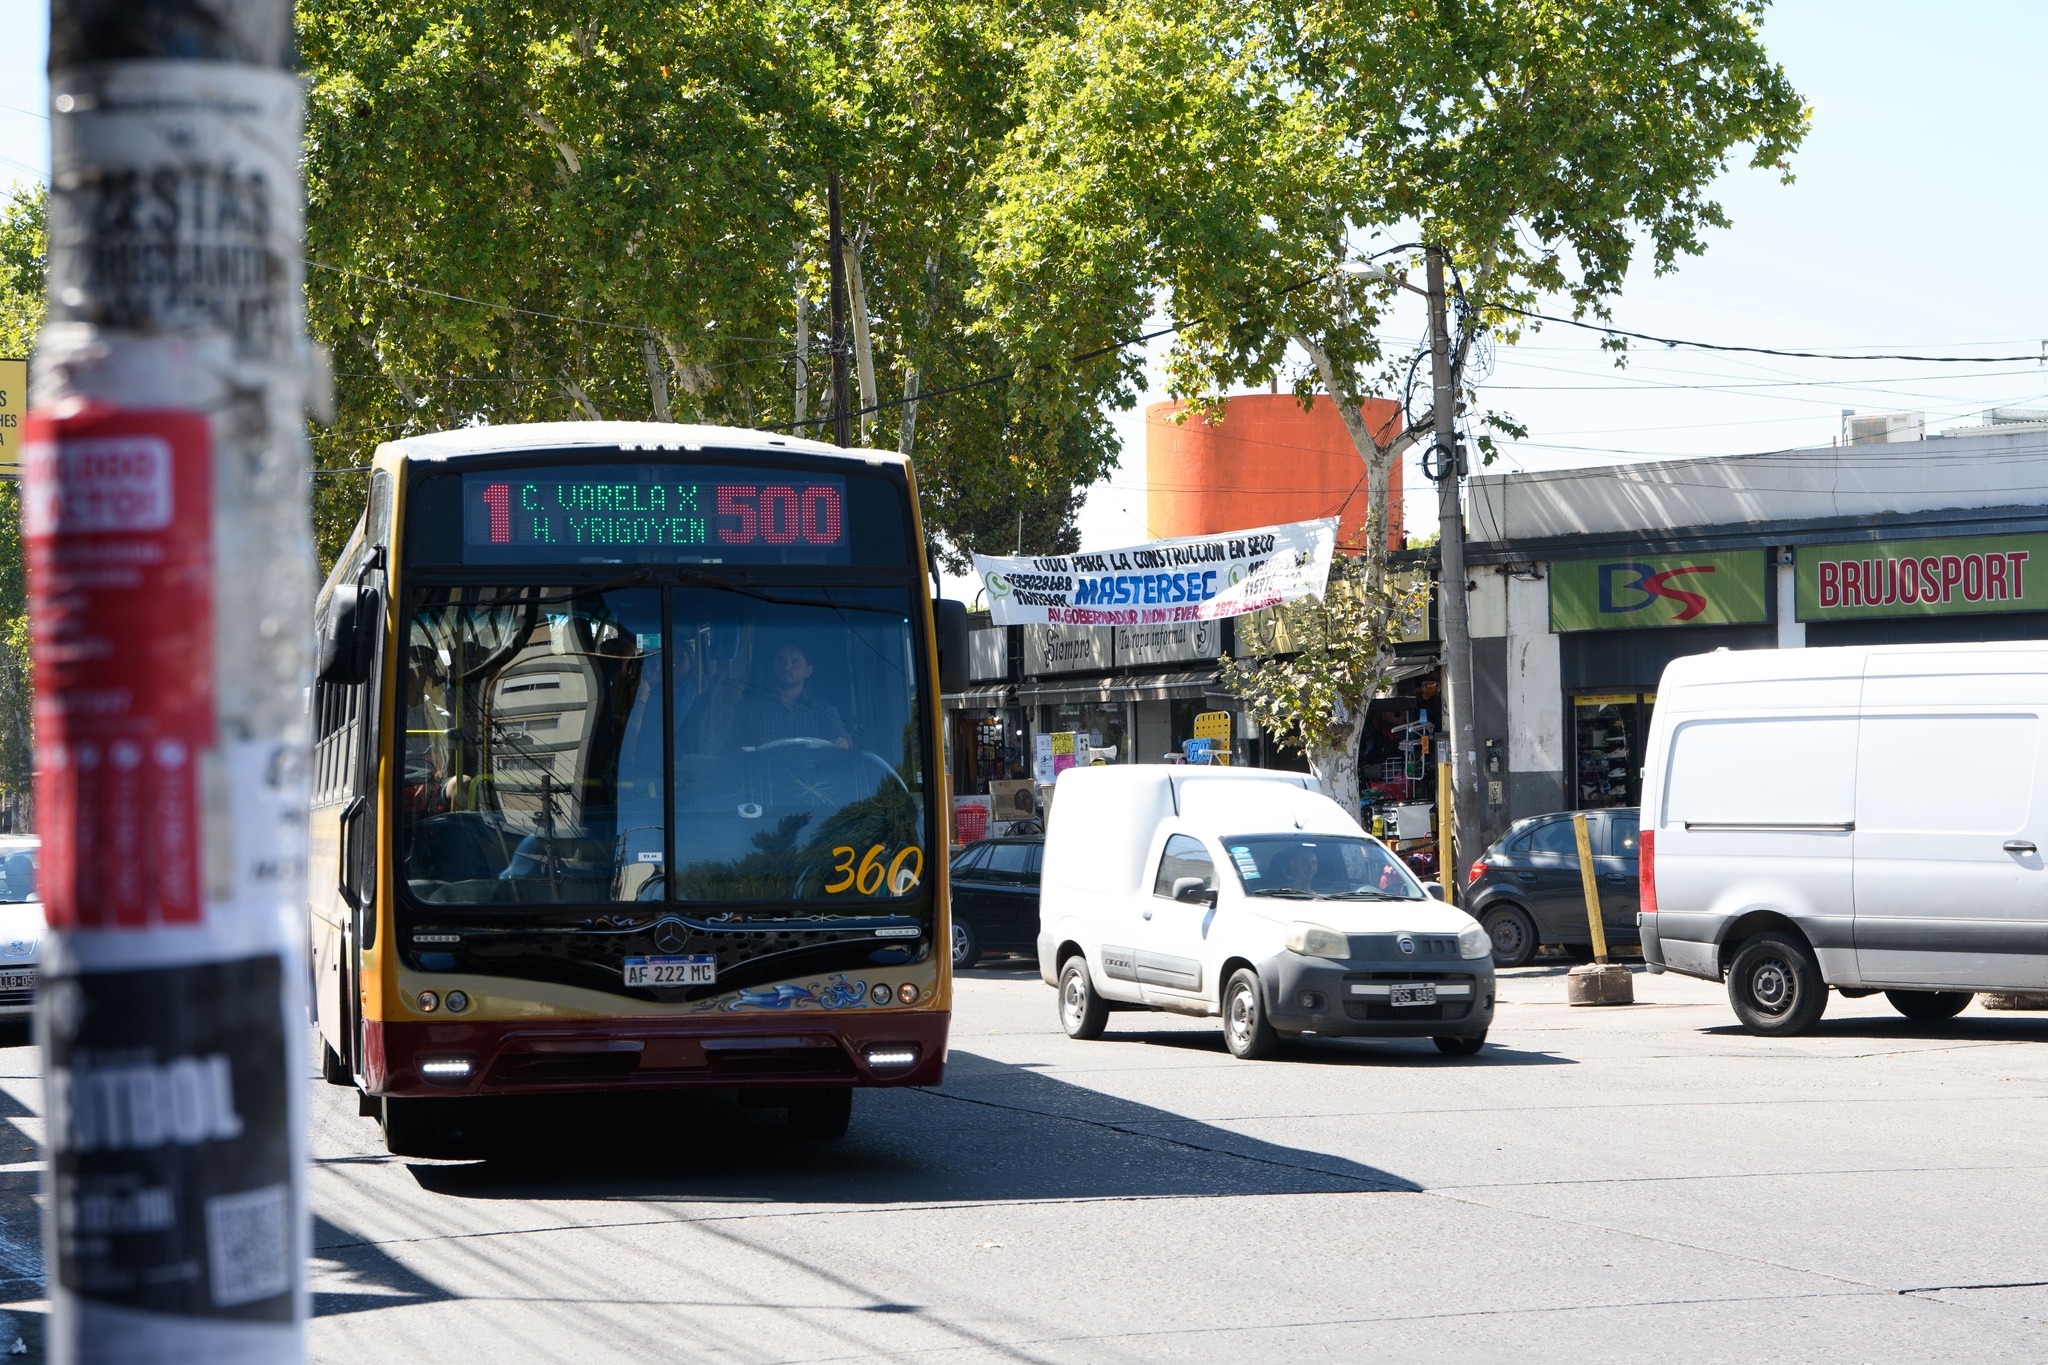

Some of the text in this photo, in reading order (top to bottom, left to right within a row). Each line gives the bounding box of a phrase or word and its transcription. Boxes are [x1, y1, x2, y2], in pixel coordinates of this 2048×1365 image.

[483, 484, 509, 543] 1
[521, 484, 698, 512] C. VARELA X
[717, 485, 841, 544] 500
[533, 517, 705, 544] H. YRIGOYEN
[1071, 554, 1109, 573] PARA
[1110, 551, 1132, 571] LA
[1133, 542, 1226, 568] CONSTRUCCION
[1227, 538, 1246, 560] EN
[1248, 534, 1276, 557] SECO
[1074, 570, 1217, 606] MASTERSEC
[1817, 550, 2029, 609] BRUJOSPORT
[1141, 604, 1211, 624] MONTEVERD
[1044, 624, 1090, 669] Siempre
[1119, 627, 1187, 656] Tu ropa informal
[824, 843, 924, 895] 360
[628, 965, 712, 984] AF 222 MC
